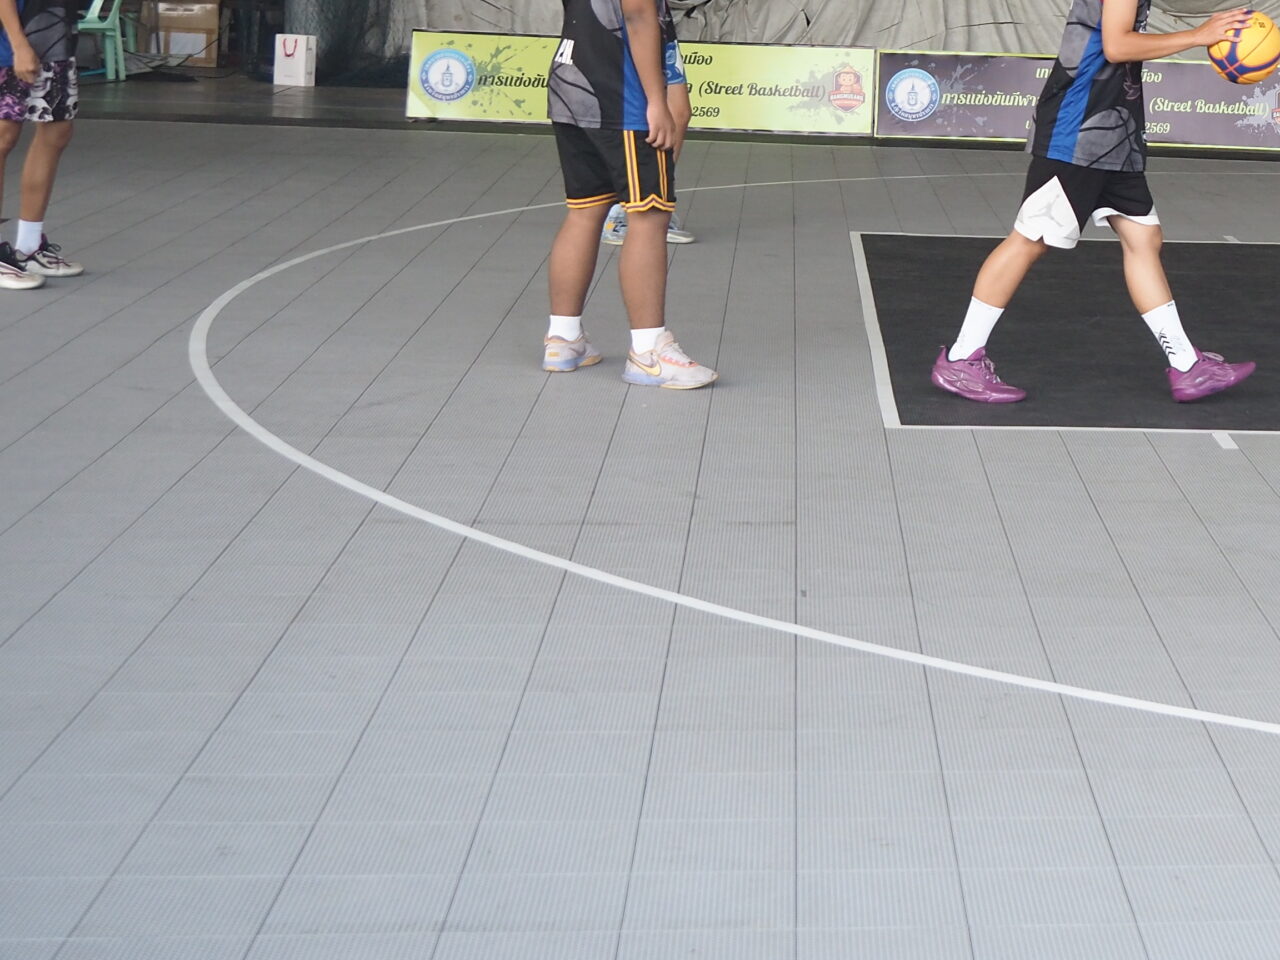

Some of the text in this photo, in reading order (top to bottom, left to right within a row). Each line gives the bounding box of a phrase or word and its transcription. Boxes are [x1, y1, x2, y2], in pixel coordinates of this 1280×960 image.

[698, 80, 827, 103] (Street Basketball)
[1149, 96, 1271, 120] (Street Basketball)
